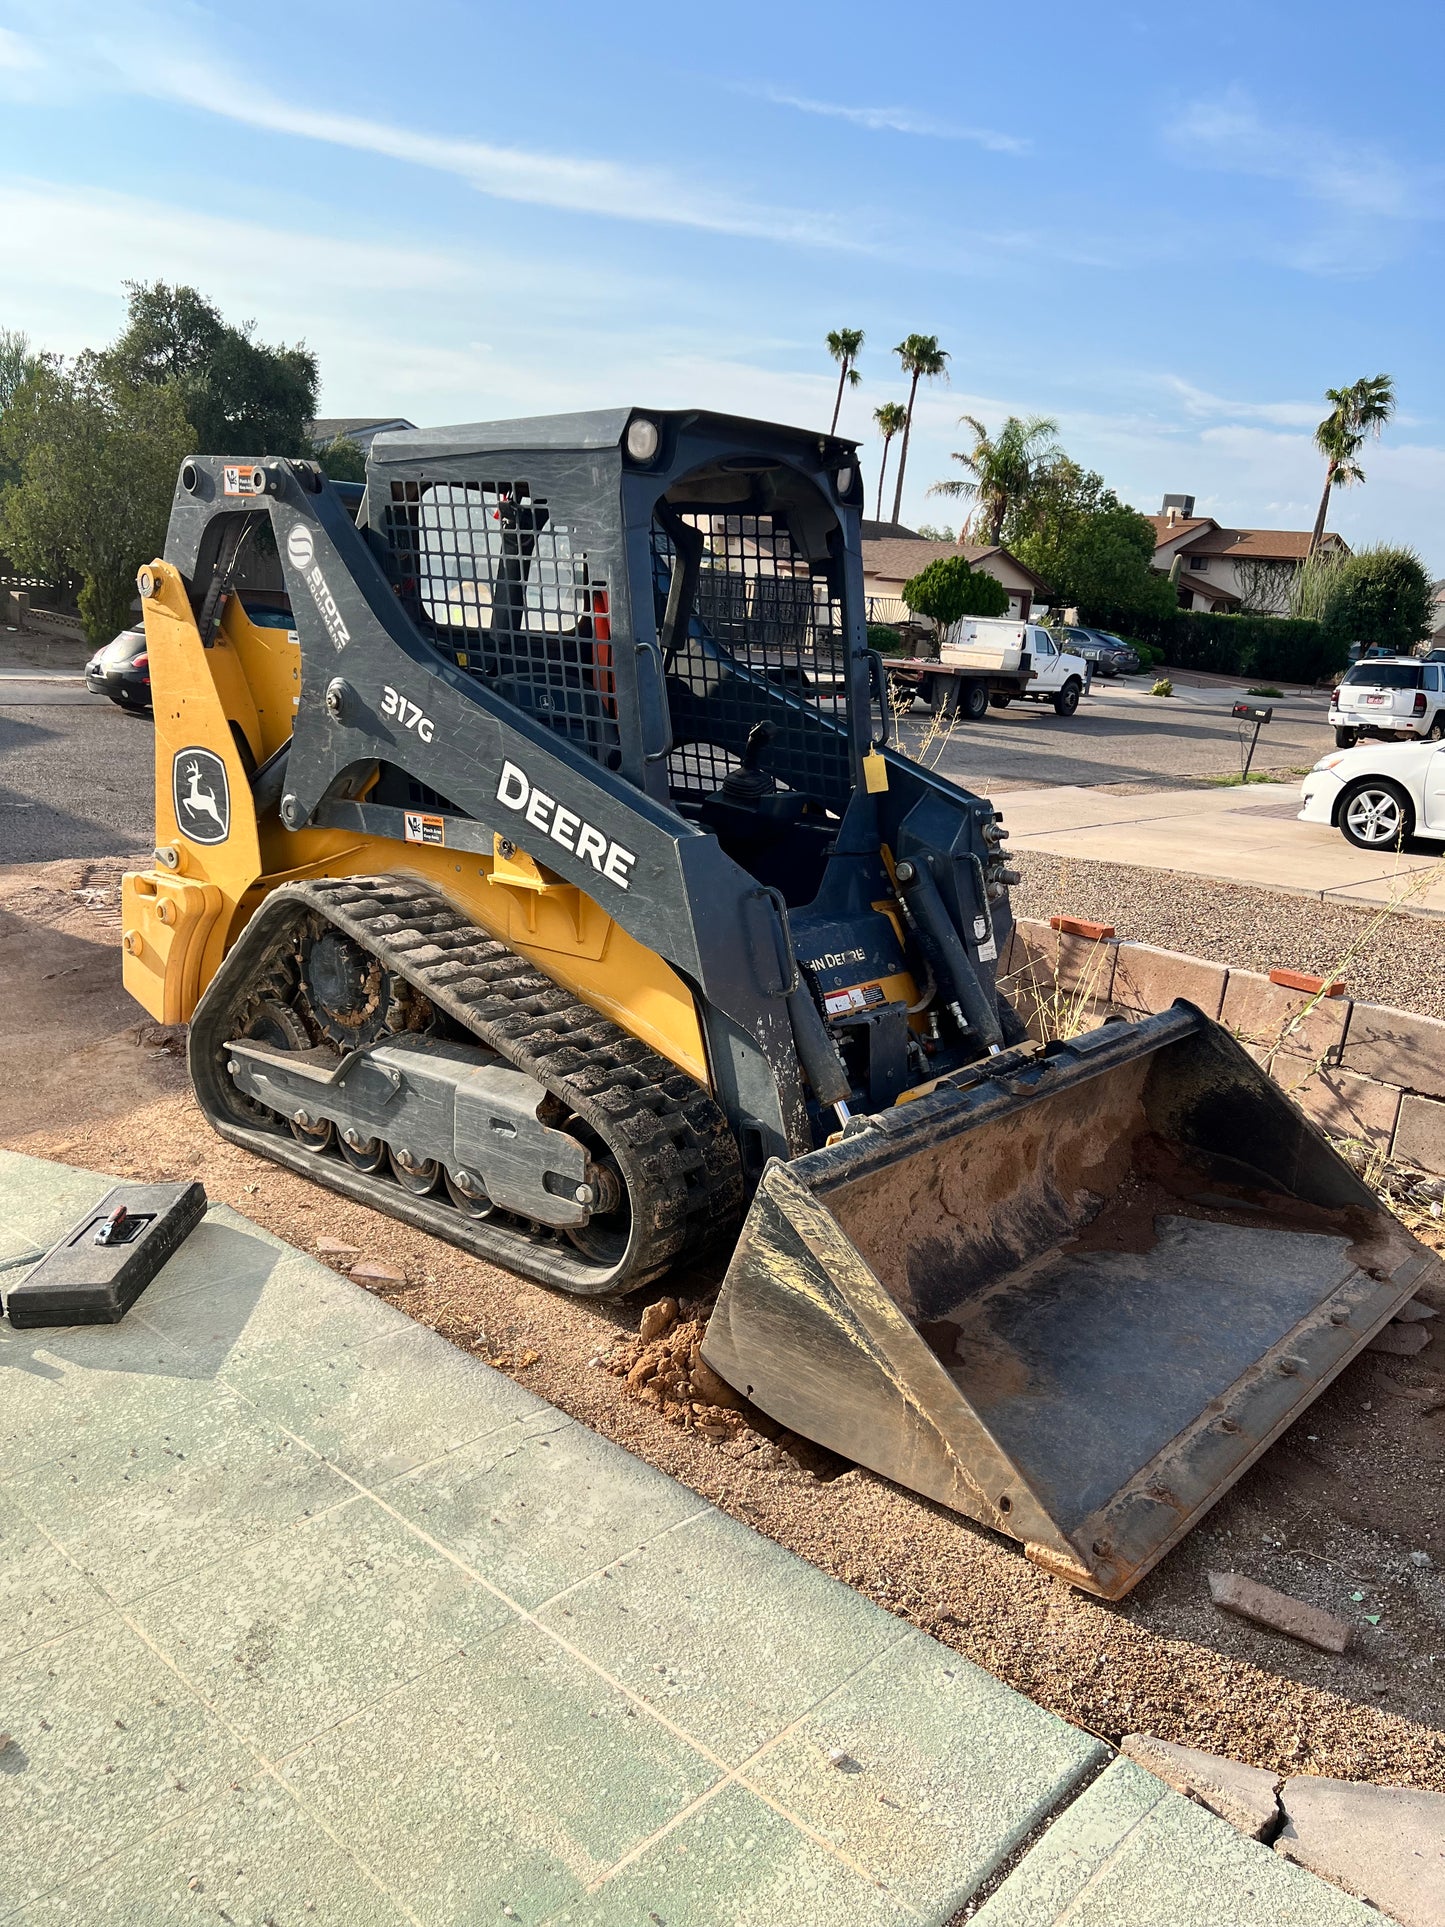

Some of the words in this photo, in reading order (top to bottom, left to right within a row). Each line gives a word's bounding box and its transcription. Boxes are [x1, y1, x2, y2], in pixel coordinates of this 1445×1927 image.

[306, 575, 343, 651] EQUIPMENT
[311, 566, 352, 646] STOTZ
[380, 685, 435, 743] 317G
[496, 760, 636, 890] DEERE
